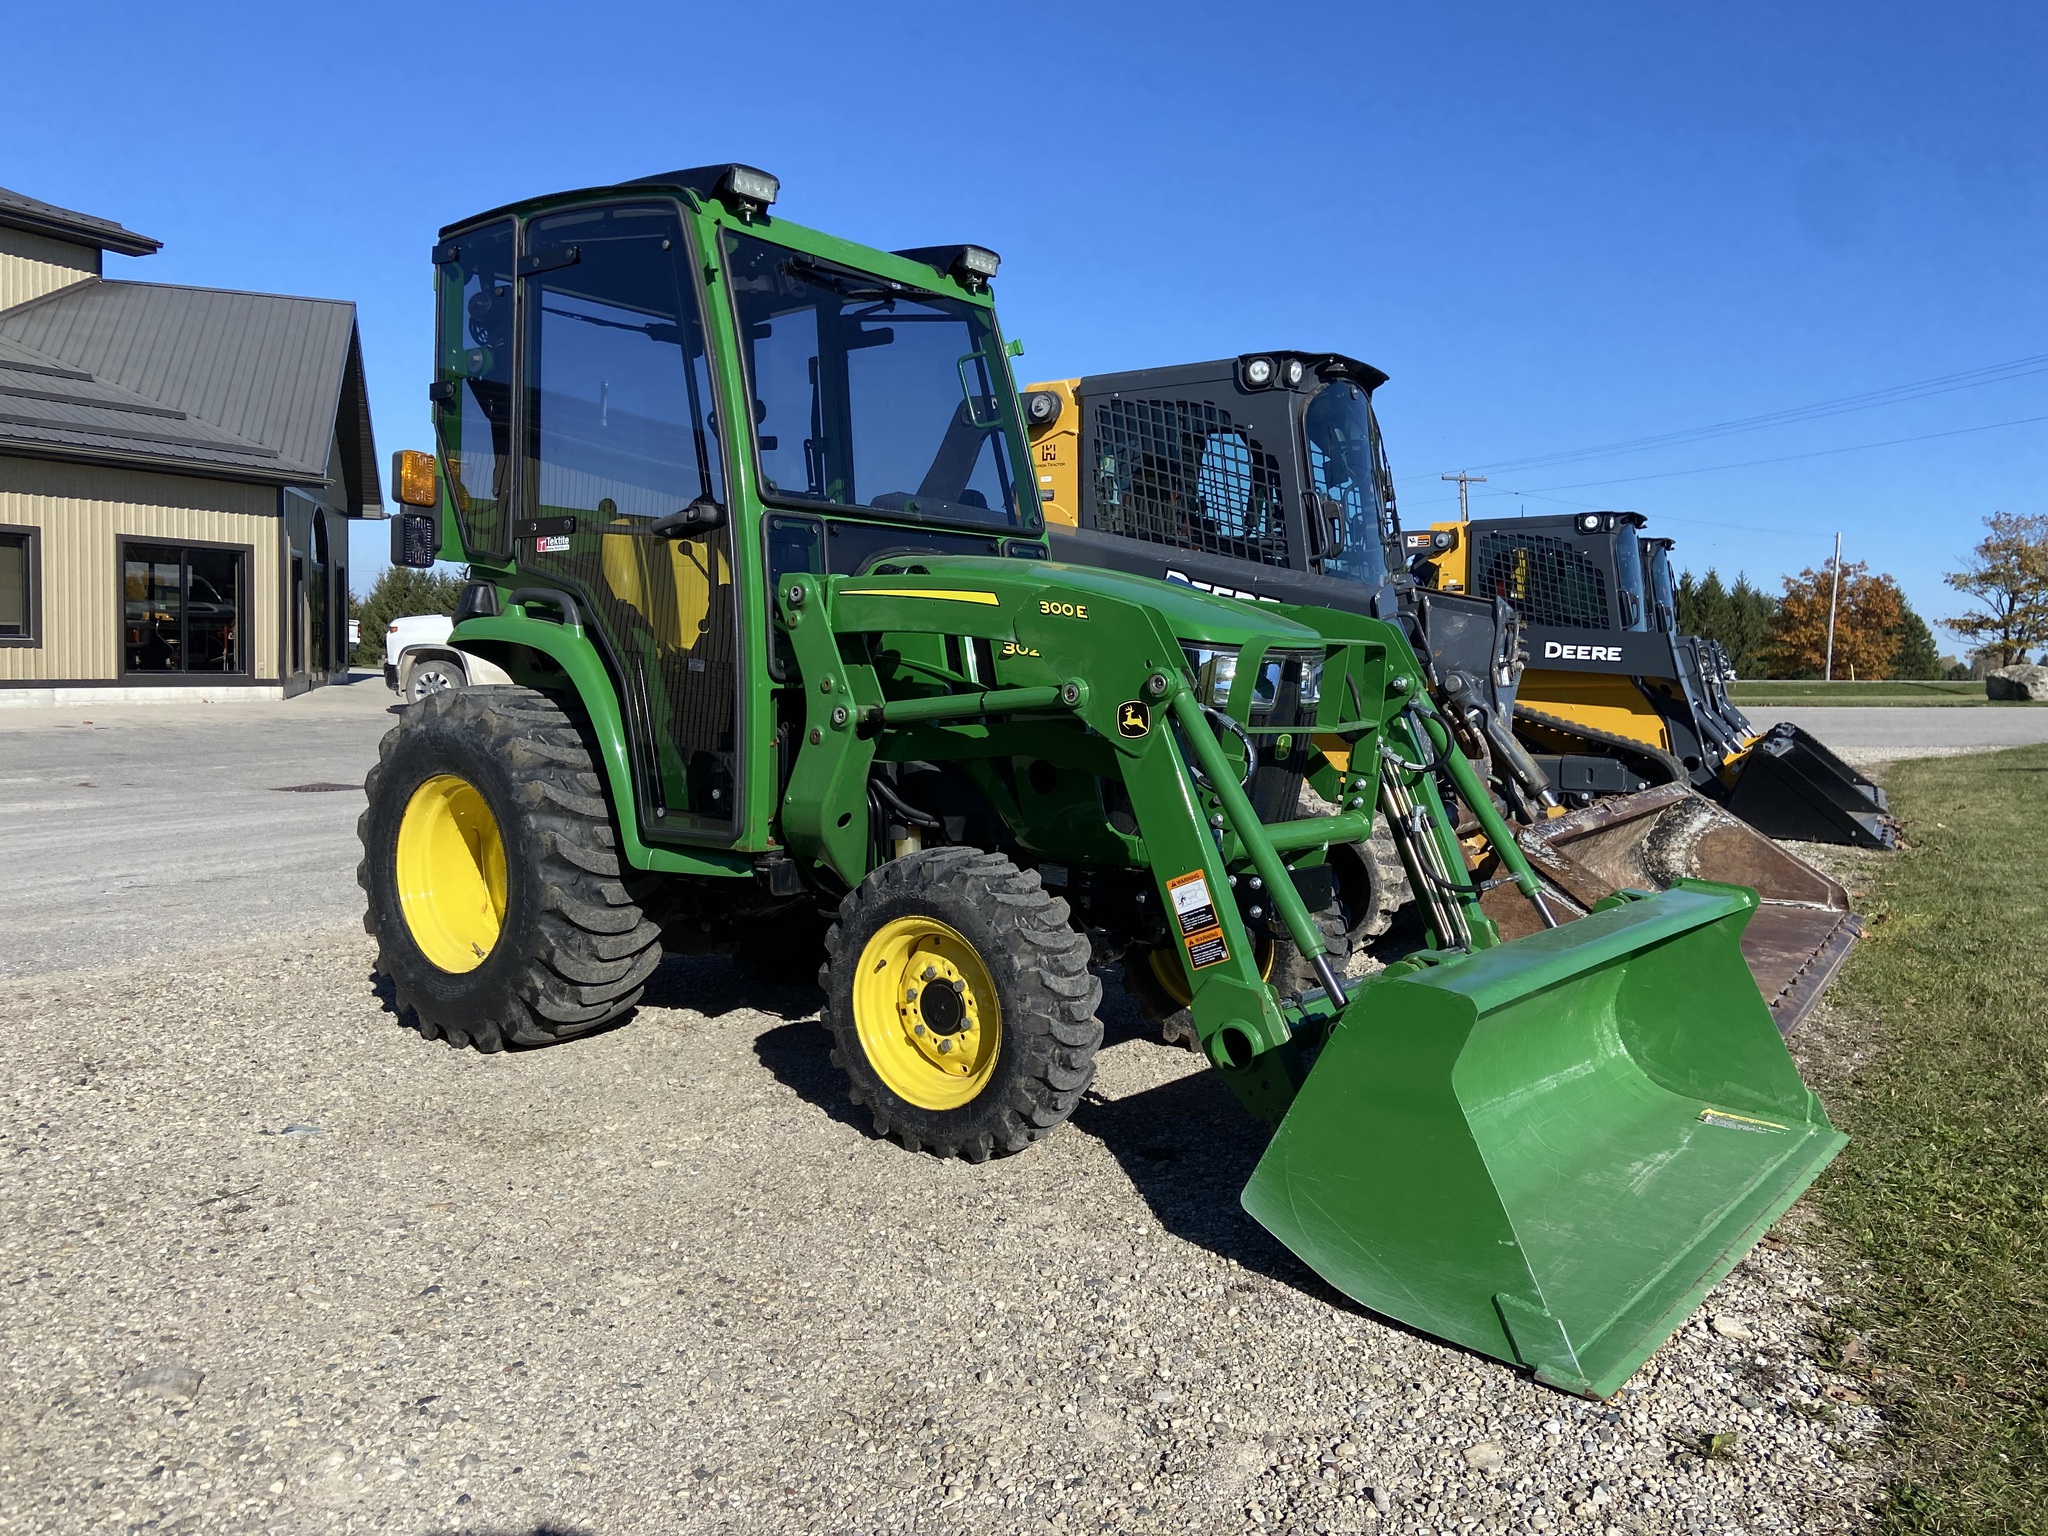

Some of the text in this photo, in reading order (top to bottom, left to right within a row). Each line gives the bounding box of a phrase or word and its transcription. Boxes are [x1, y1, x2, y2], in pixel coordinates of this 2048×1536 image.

[546, 536, 569, 545] Tektite
[1544, 641, 1623, 662] DEERE
[1177, 873, 1200, 885] WARNING
[1195, 932, 1219, 943] WARNING
